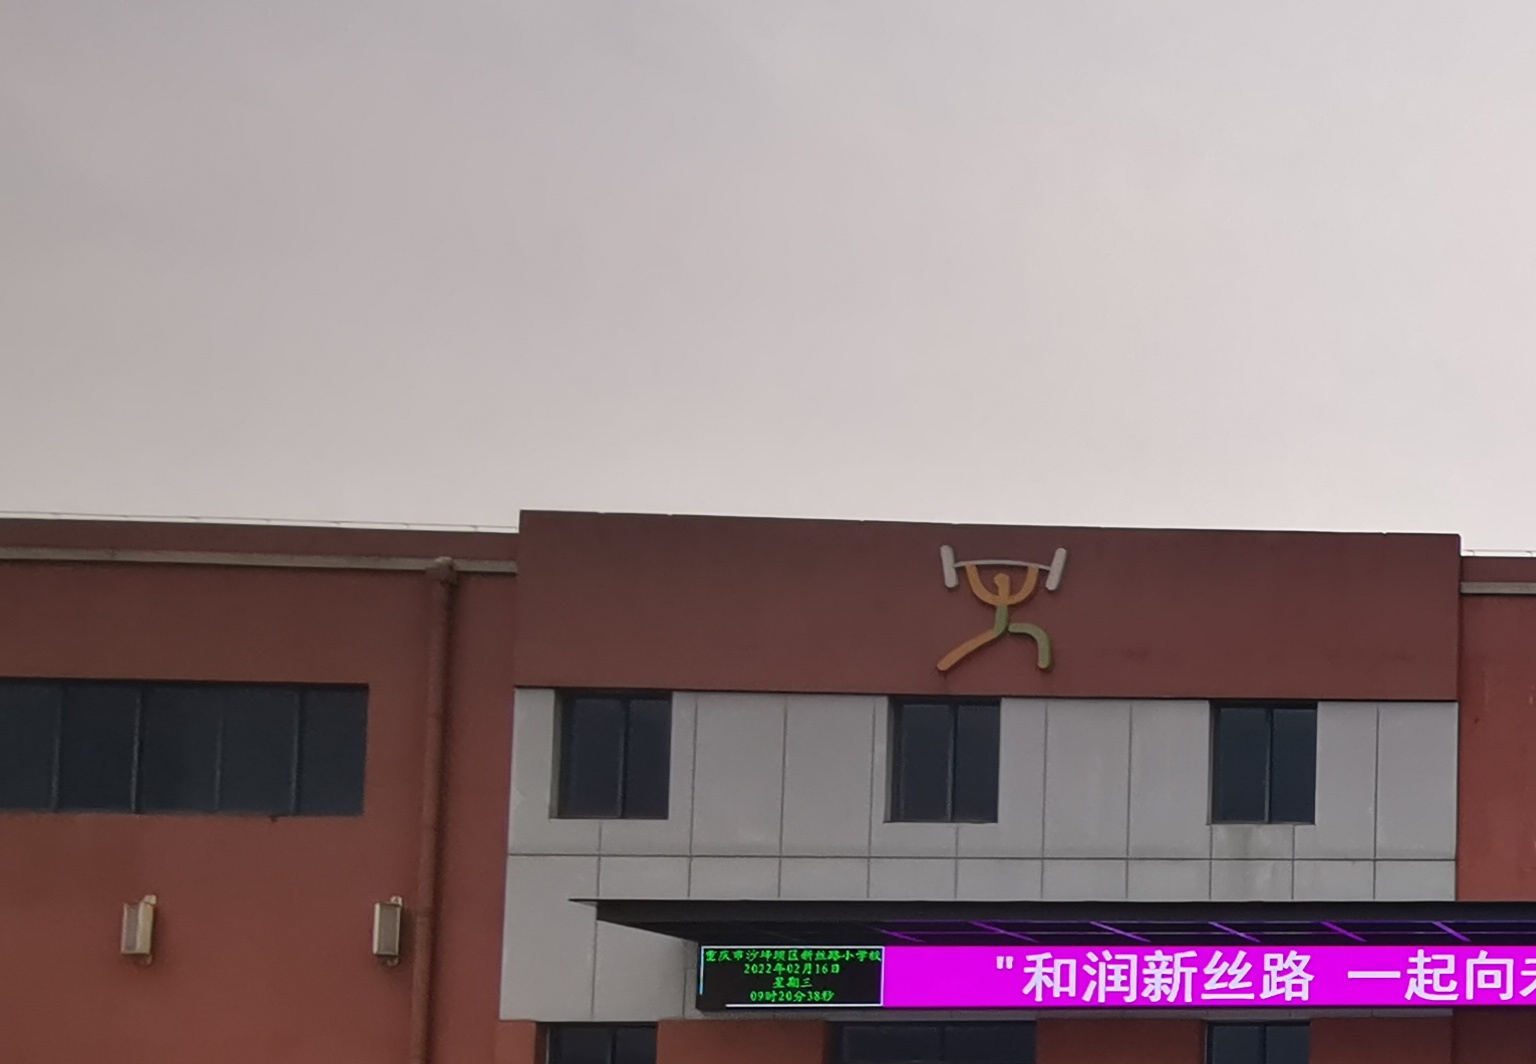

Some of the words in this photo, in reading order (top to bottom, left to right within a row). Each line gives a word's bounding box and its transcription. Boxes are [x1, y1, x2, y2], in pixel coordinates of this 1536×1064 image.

[744, 963, 840, 974] 2022年02月16日
[773, 977, 812, 988] 星期三
